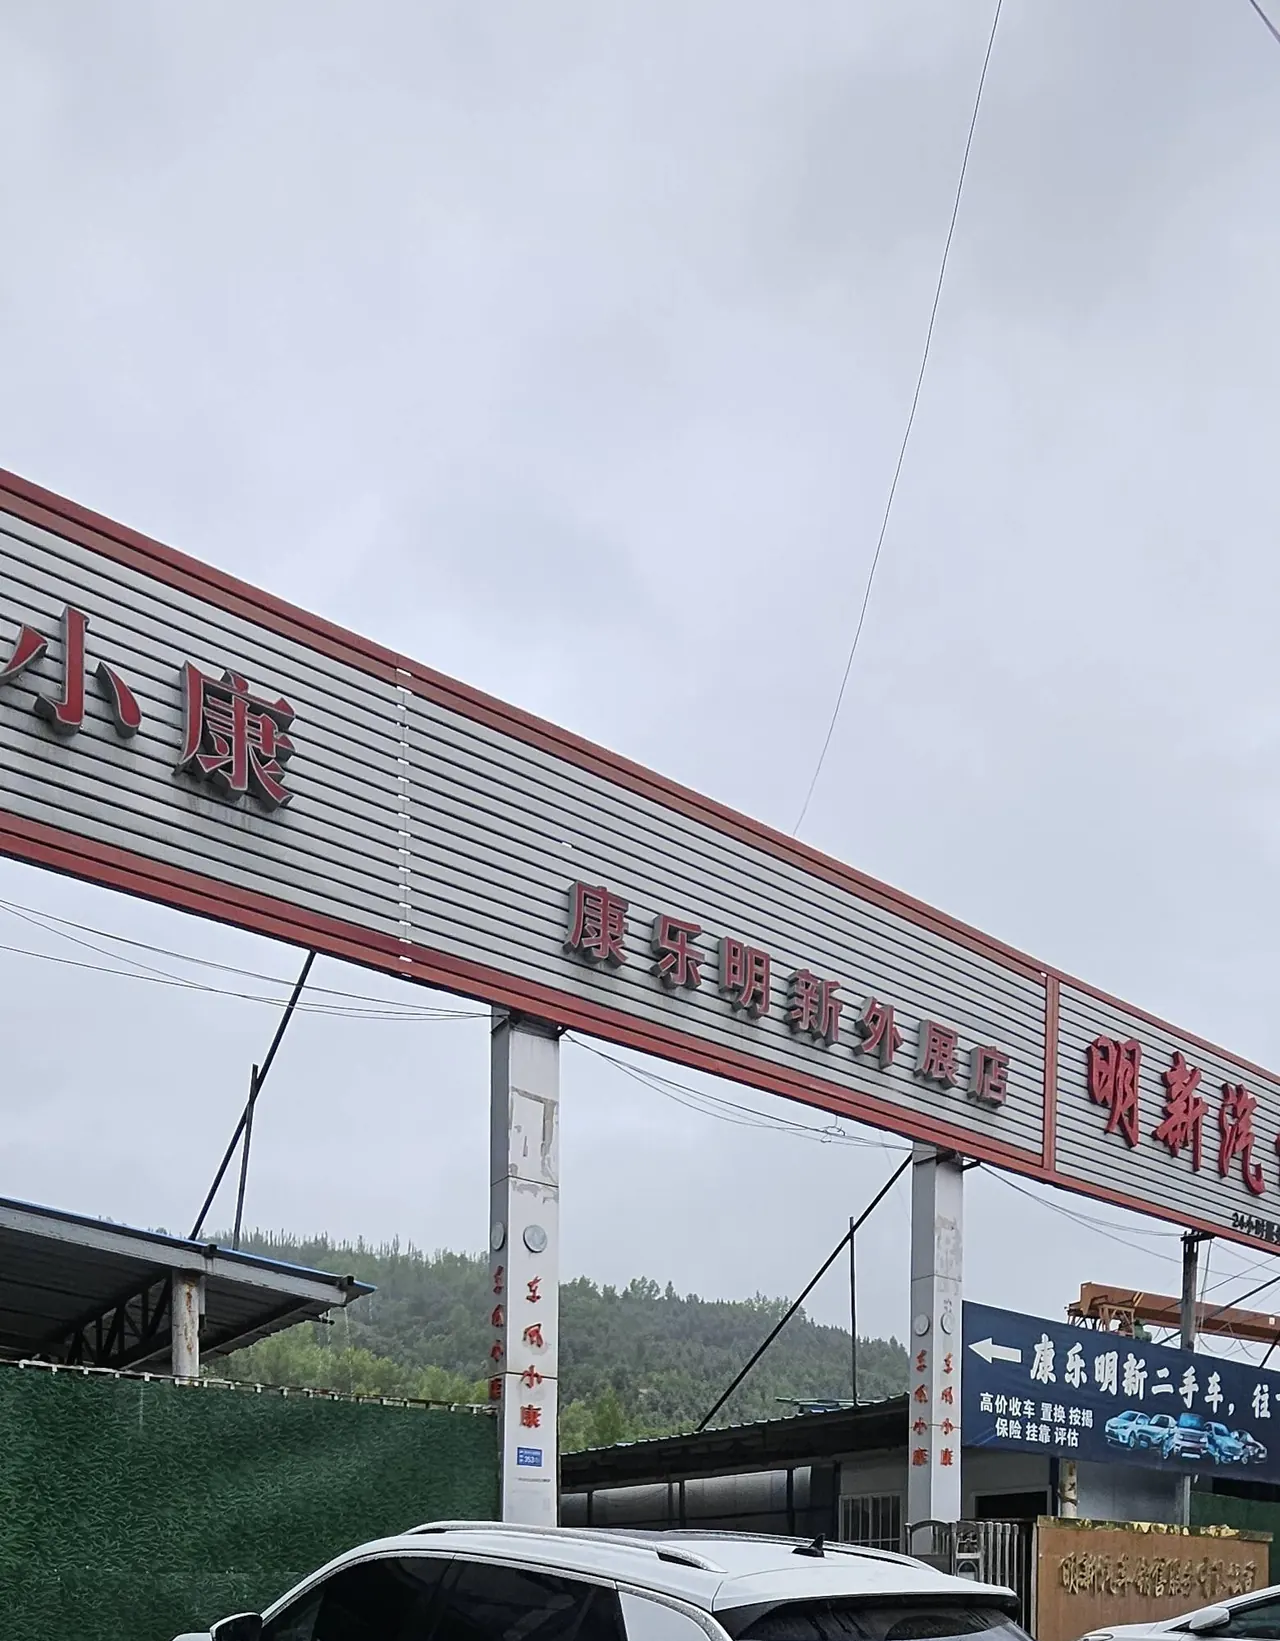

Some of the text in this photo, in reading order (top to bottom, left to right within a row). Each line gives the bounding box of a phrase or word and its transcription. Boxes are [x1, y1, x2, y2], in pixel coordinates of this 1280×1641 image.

[0, 605, 297, 812] 小康
[563, 880, 1010, 1108] 康乐明新外展店
[1086, 1035, 1280, 1195] 明新汽
[980, 1391, 1094, 1429] 高价收车 置换 按揭
[995, 1417, 1079, 1448] 保险 挂靠 评估
[1030, 1333, 1280, 1419] 康乐明新二手车，往
